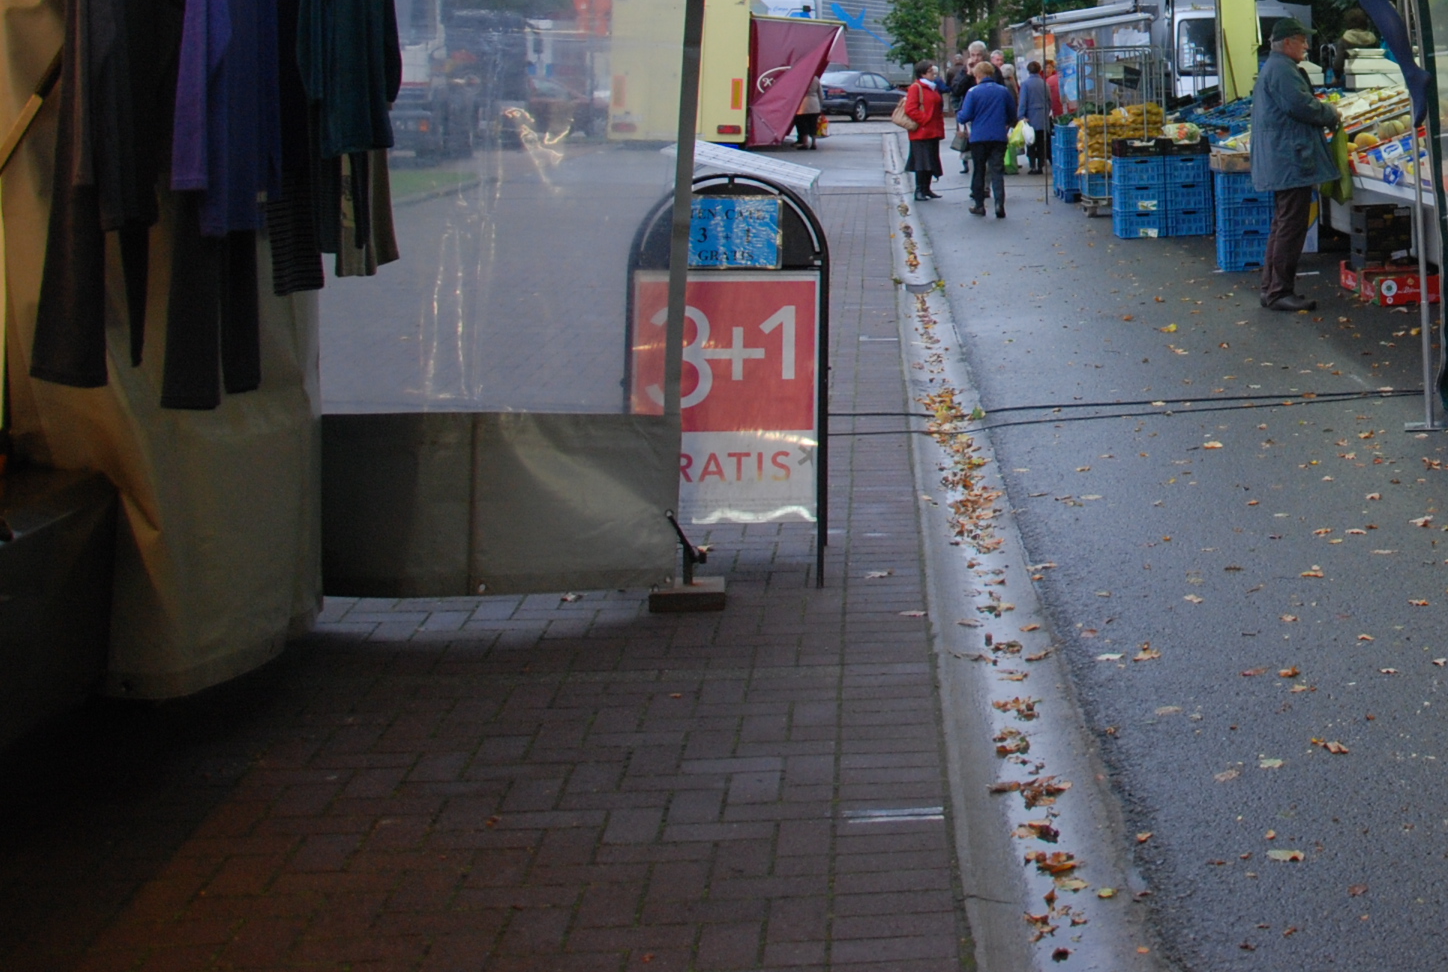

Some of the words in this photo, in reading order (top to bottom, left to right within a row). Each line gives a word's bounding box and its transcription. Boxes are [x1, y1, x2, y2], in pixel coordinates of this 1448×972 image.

[697, 227, 708, 244] 3
[697, 249, 754, 262] GRATIS
[644, 304, 796, 409] 3+1
[680, 450, 791, 482] RATIS
